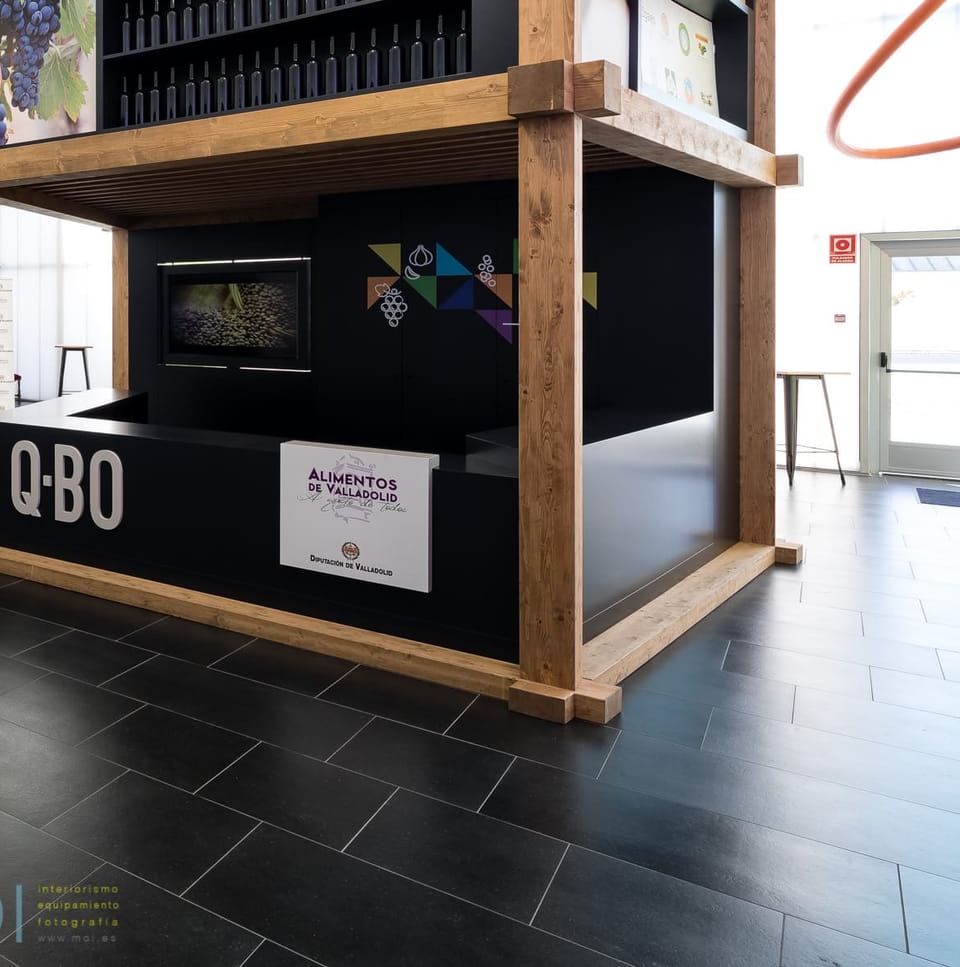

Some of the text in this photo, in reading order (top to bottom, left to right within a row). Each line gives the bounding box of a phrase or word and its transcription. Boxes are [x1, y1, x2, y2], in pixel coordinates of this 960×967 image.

[11, 440, 124, 530] Q-BO
[308, 467, 398, 491] ALIMENTOS
[309, 482, 398, 503] DE VALLADOLID
[355, 562, 393, 577] VALLADOLID
